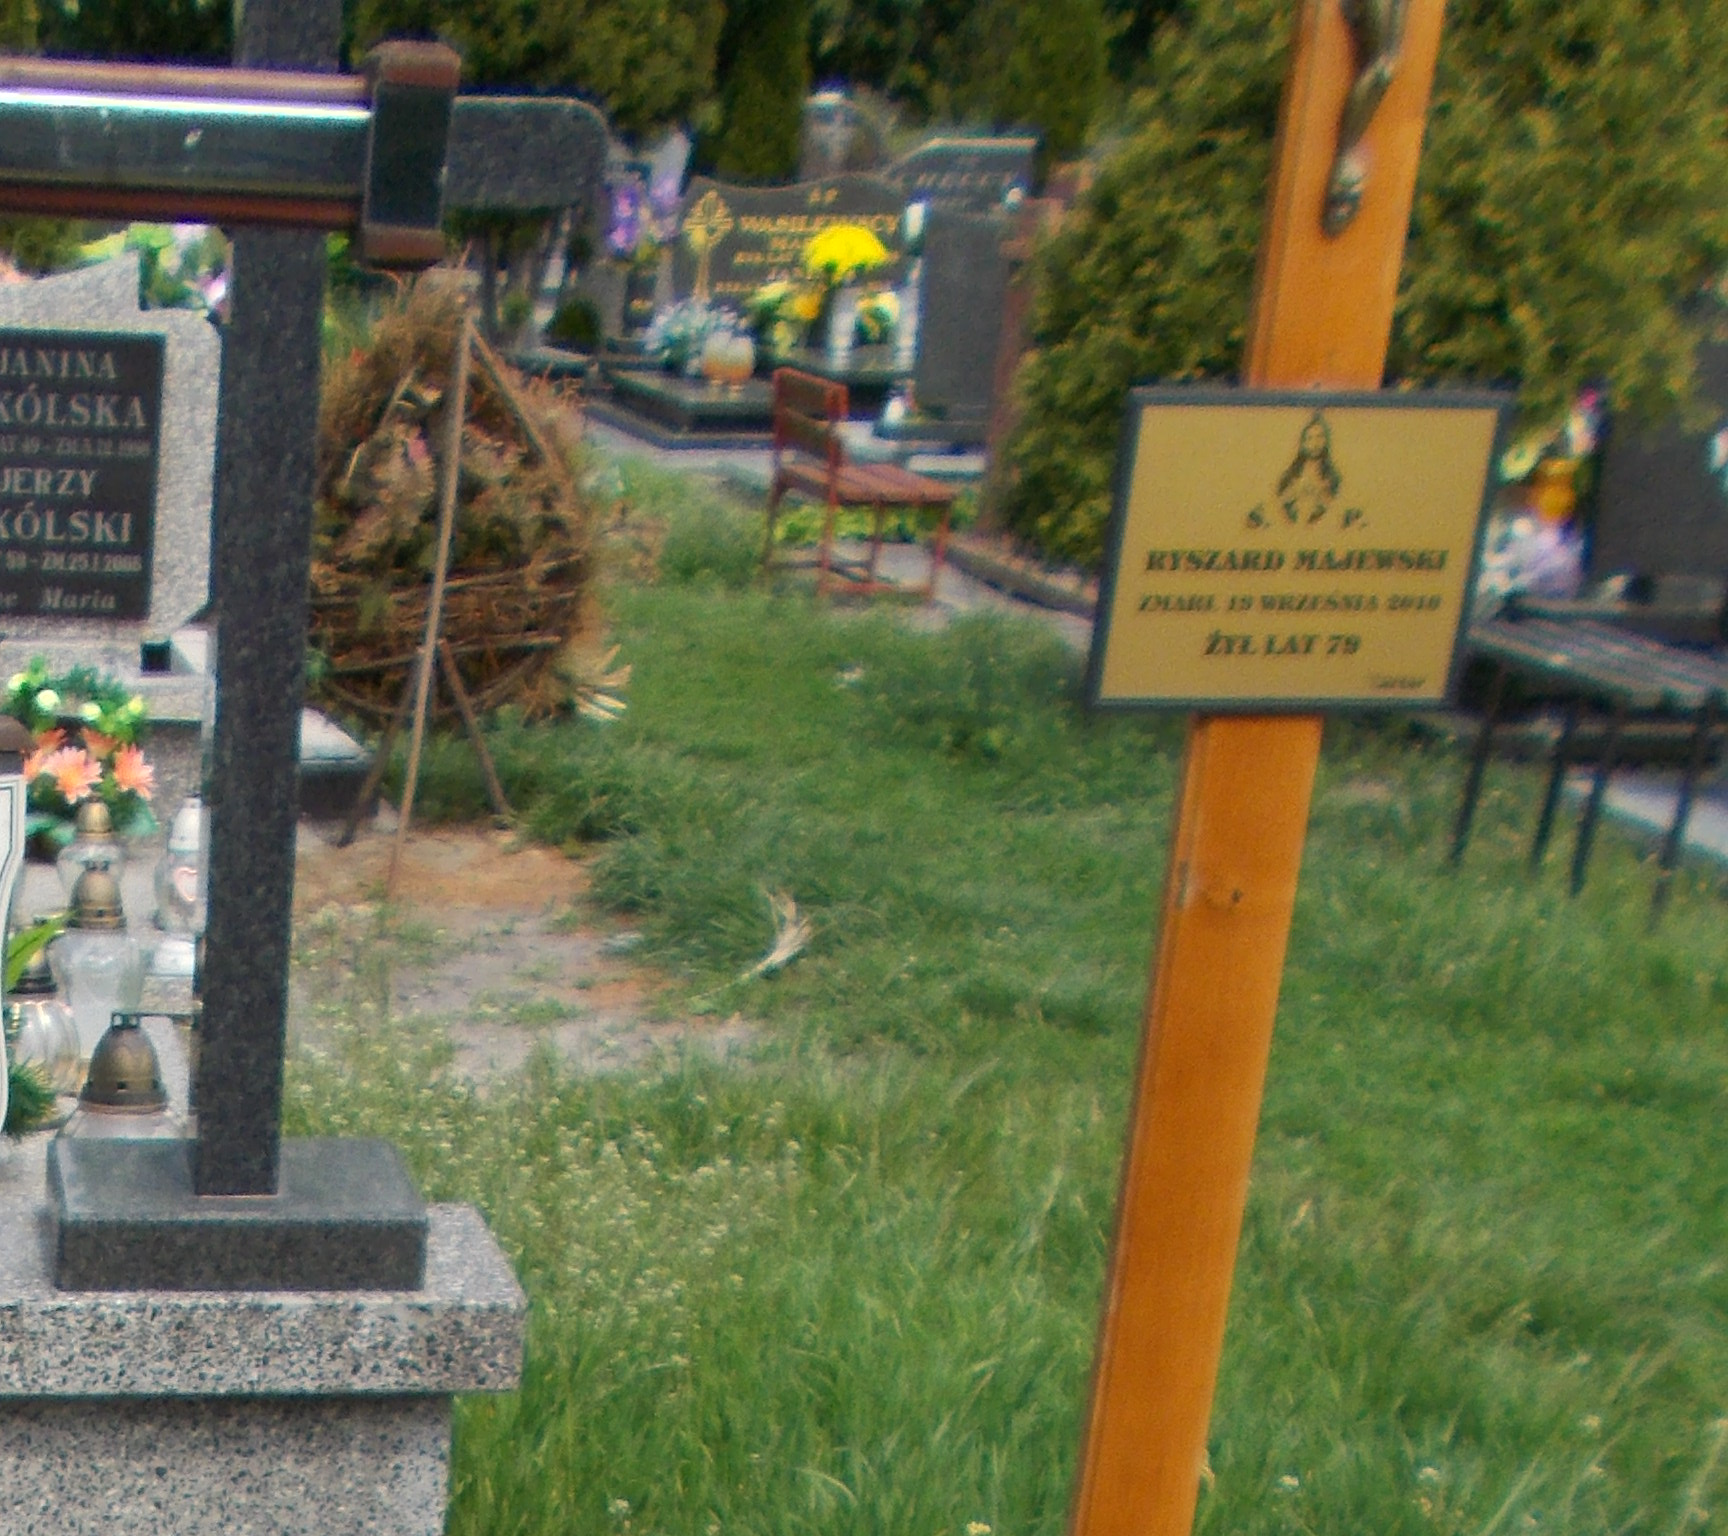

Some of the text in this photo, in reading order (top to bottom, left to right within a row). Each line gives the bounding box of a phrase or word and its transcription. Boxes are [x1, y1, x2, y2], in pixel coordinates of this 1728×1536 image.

[1145, 549, 1449, 571] RYSZARD MAJEWSKI
[38, 586, 116, 609] Maria
[1263, 634, 1318, 655] LAT
[1325, 634, 1362, 655] 79
